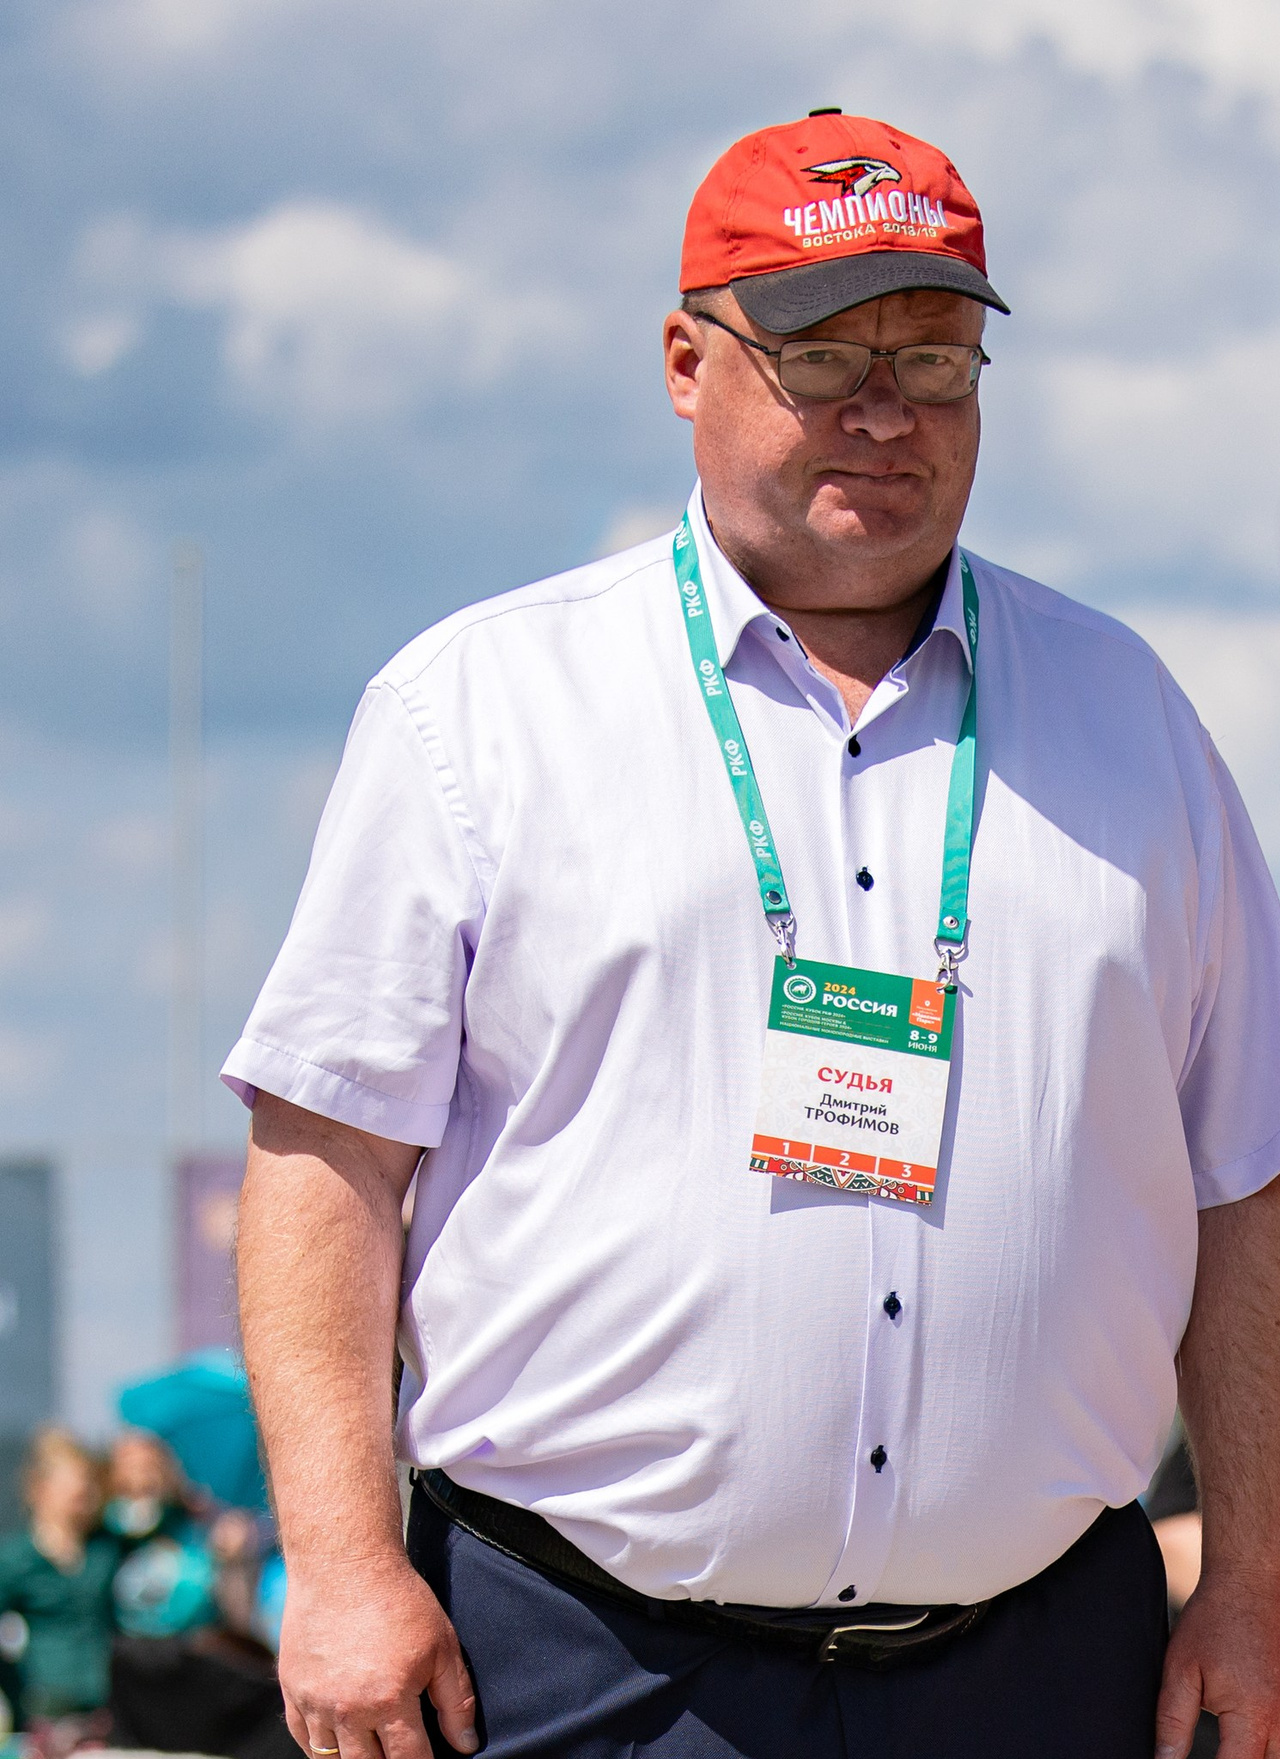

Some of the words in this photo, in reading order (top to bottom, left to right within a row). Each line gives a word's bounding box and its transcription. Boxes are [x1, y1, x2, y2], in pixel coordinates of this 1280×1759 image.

[784, 191, 949, 236] ЧЕМПИОНЫ
[802, 223, 876, 248] ВОСТОКА
[682, 580, 704, 618] РКФ
[699, 658, 723, 697] РКФ
[724, 738, 748, 777] РКФ
[749, 820, 773, 859] РКФ
[823, 982, 856, 996] 2024
[822, 993, 898, 1018] РОССИЯ
[908, 1041, 938, 1053] ИЮНЯ
[817, 1066, 893, 1093] СУДЬЯ
[819, 1093, 887, 1116] Дмитрий
[804, 1106, 900, 1135] ТРОФИМОВ
[782, 1142, 790, 1155] 1
[839, 1153, 850, 1166] 2
[901, 1164, 912, 1177] 3
